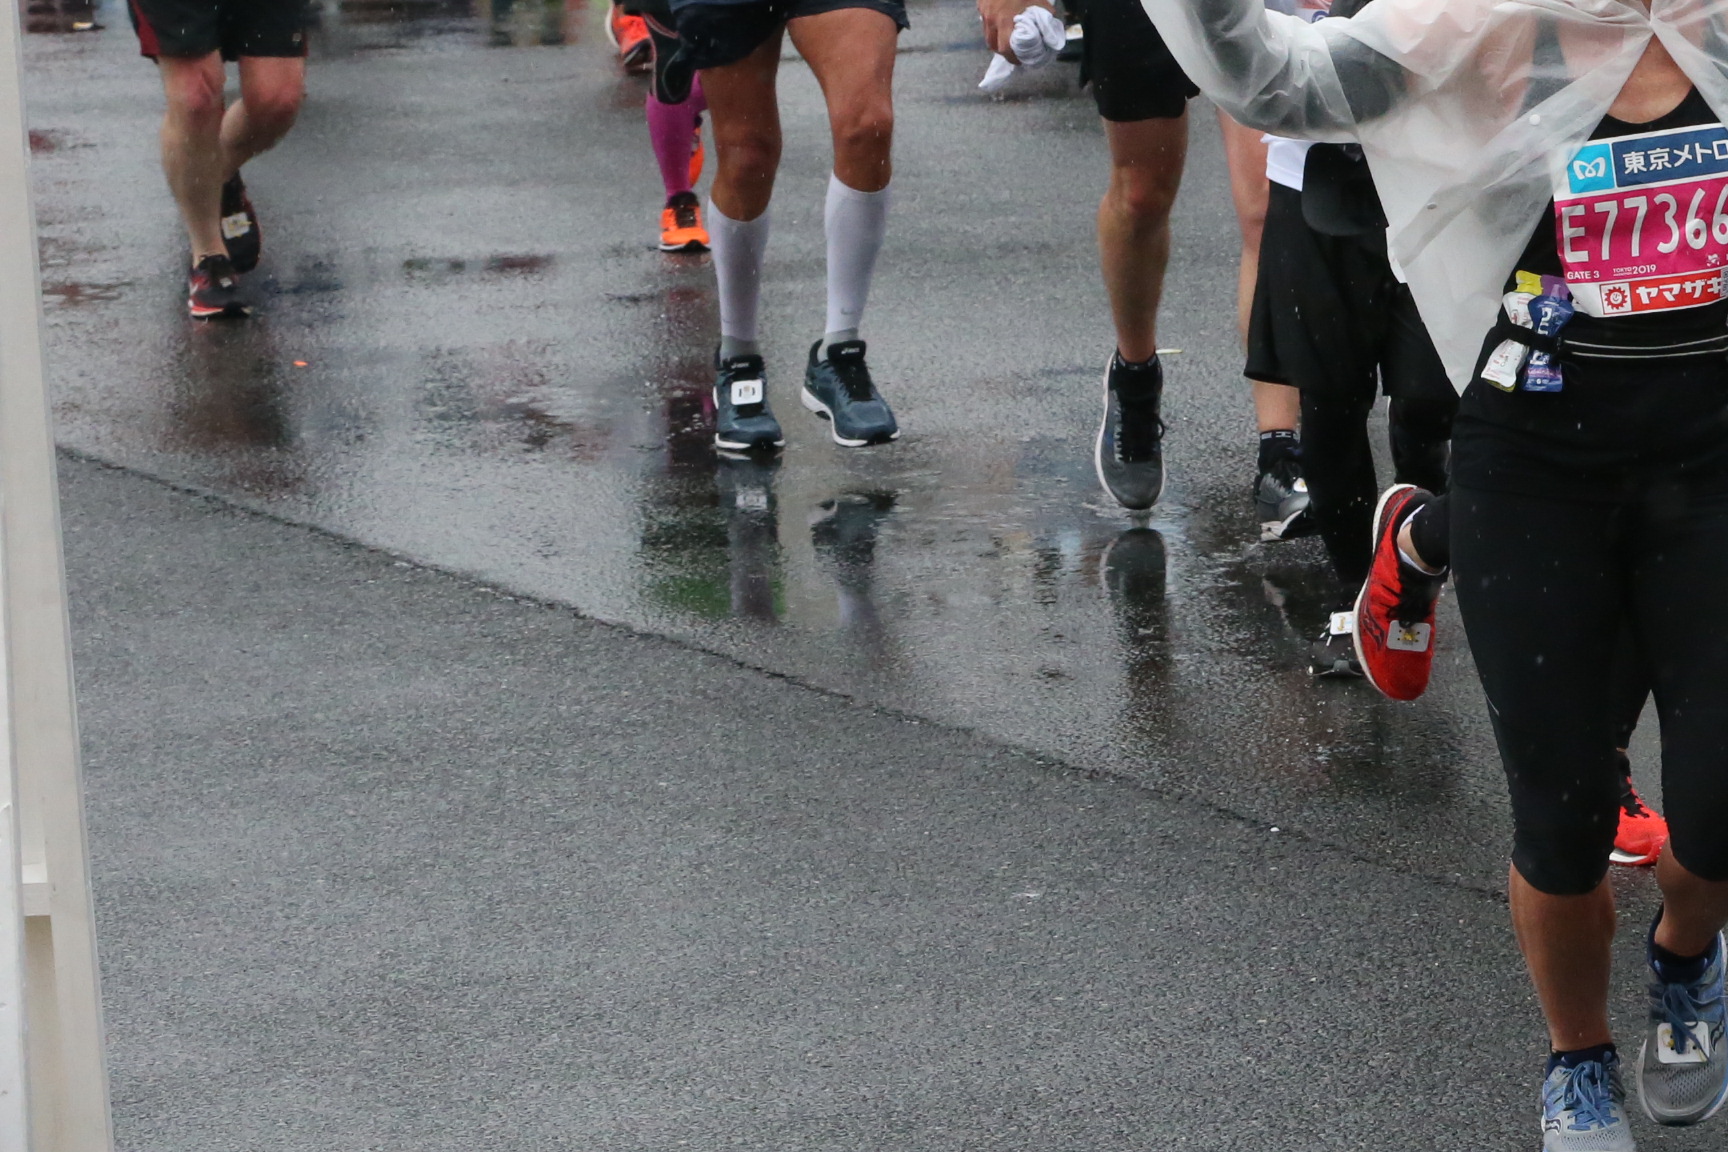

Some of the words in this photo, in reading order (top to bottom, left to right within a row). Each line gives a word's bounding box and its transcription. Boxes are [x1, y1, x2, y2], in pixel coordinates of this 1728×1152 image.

[1566, 271, 1592, 280] GATE
[1593, 270, 1600, 279] 3
[1632, 263, 1657, 275] 2019
[1635, 276, 1722, 305] ヤマザキ
